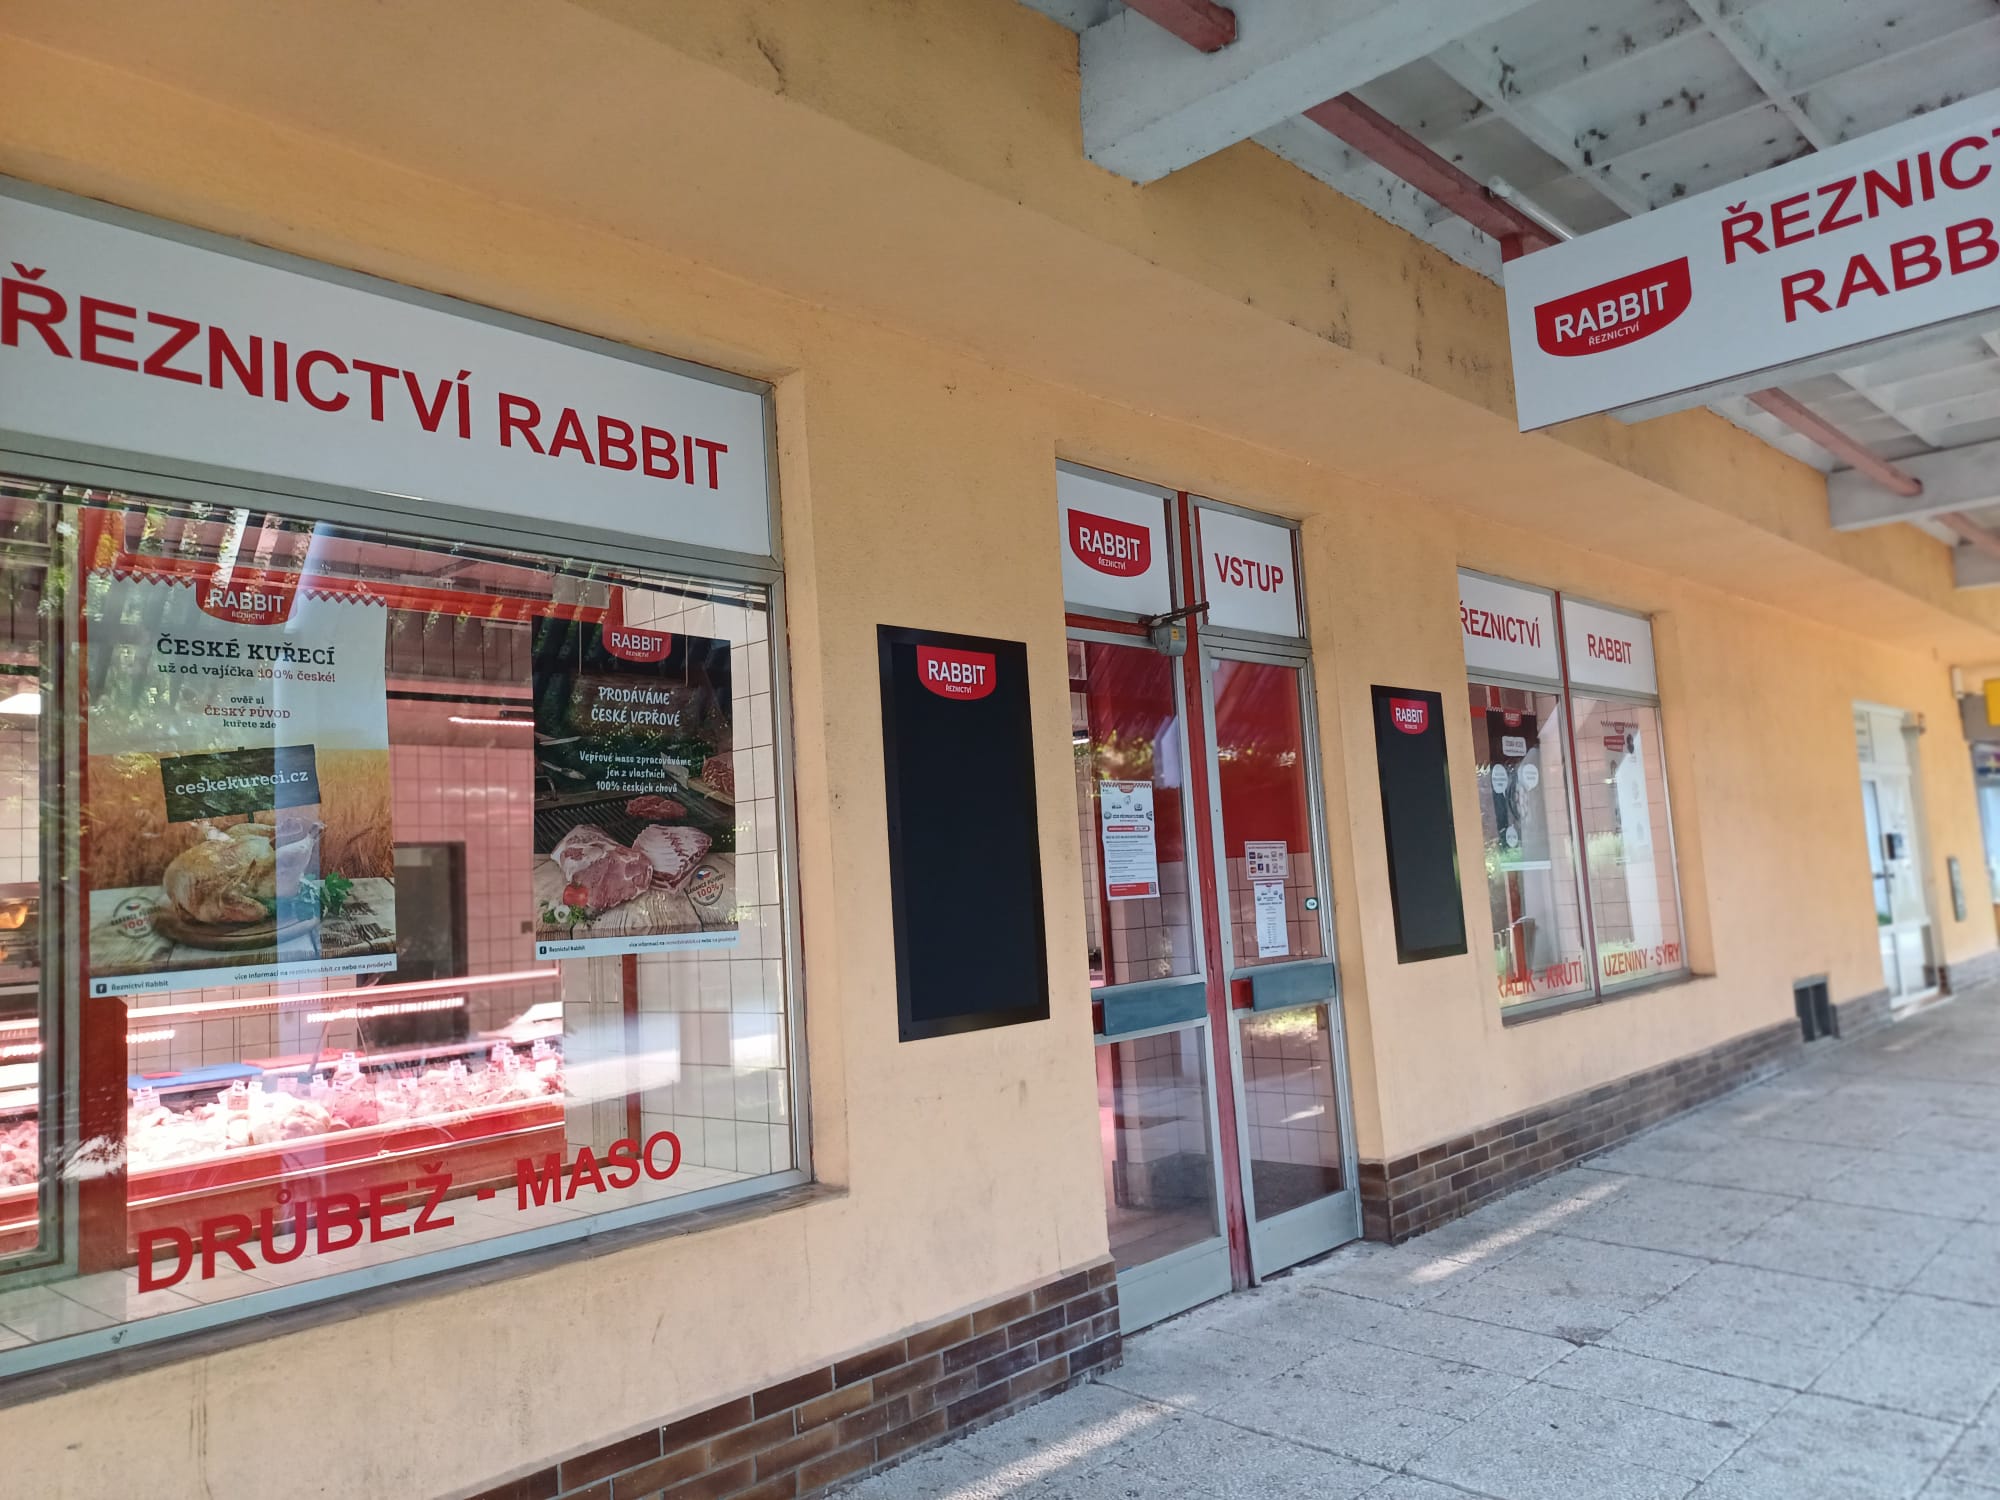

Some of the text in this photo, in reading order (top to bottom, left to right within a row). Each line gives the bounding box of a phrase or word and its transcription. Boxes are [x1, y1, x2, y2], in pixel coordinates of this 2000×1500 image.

[1721, 128, 2000, 264] ŘEZNIC
[1555, 281, 1668, 343] RABBIT
[1588, 321, 1641, 346] ŘEZNICTVÍ
[1, 262, 729, 490] ŘEZNICTVÍ RABBIT
[1080, 527, 1140, 561] RABBIT
[1098, 556, 1126, 570] ŘEZNICTVÍ
[1214, 553, 1284, 593] VSTUP
[210, 588, 285, 613] RABBIT
[157, 633, 335, 665] ČESKÉ KUŘECÍ
[611, 632, 663, 652] RABBIT
[1587, 633, 1632, 664] RABBIT
[158, 662, 336, 683] už od vajíčka 100% české!
[928, 660, 986, 685] RABBIT
[230, 695, 265, 705] ověř si
[598, 686, 670, 705] PRODÁVÁME
[204, 704, 291, 719] ČESKÝ PŮVOD
[223, 718, 277, 729] kuřete zde
[591, 704, 680, 727] ČESKÉ VEPŘOVÉ
[1395, 707, 1423, 724] RABBIT
[579, 751, 692, 767] Vepřové maso zpracováváme
[175, 769, 308, 796] ceskekureci.cz
[605, 767, 620, 779] jen
[629, 768, 665, 779] vlastních
[596, 780, 678, 795] 100% českých chovů
[1603, 948, 1647, 976] UZENINY
[136, 1131, 682, 1293] DRŮBEŽ - MASO
